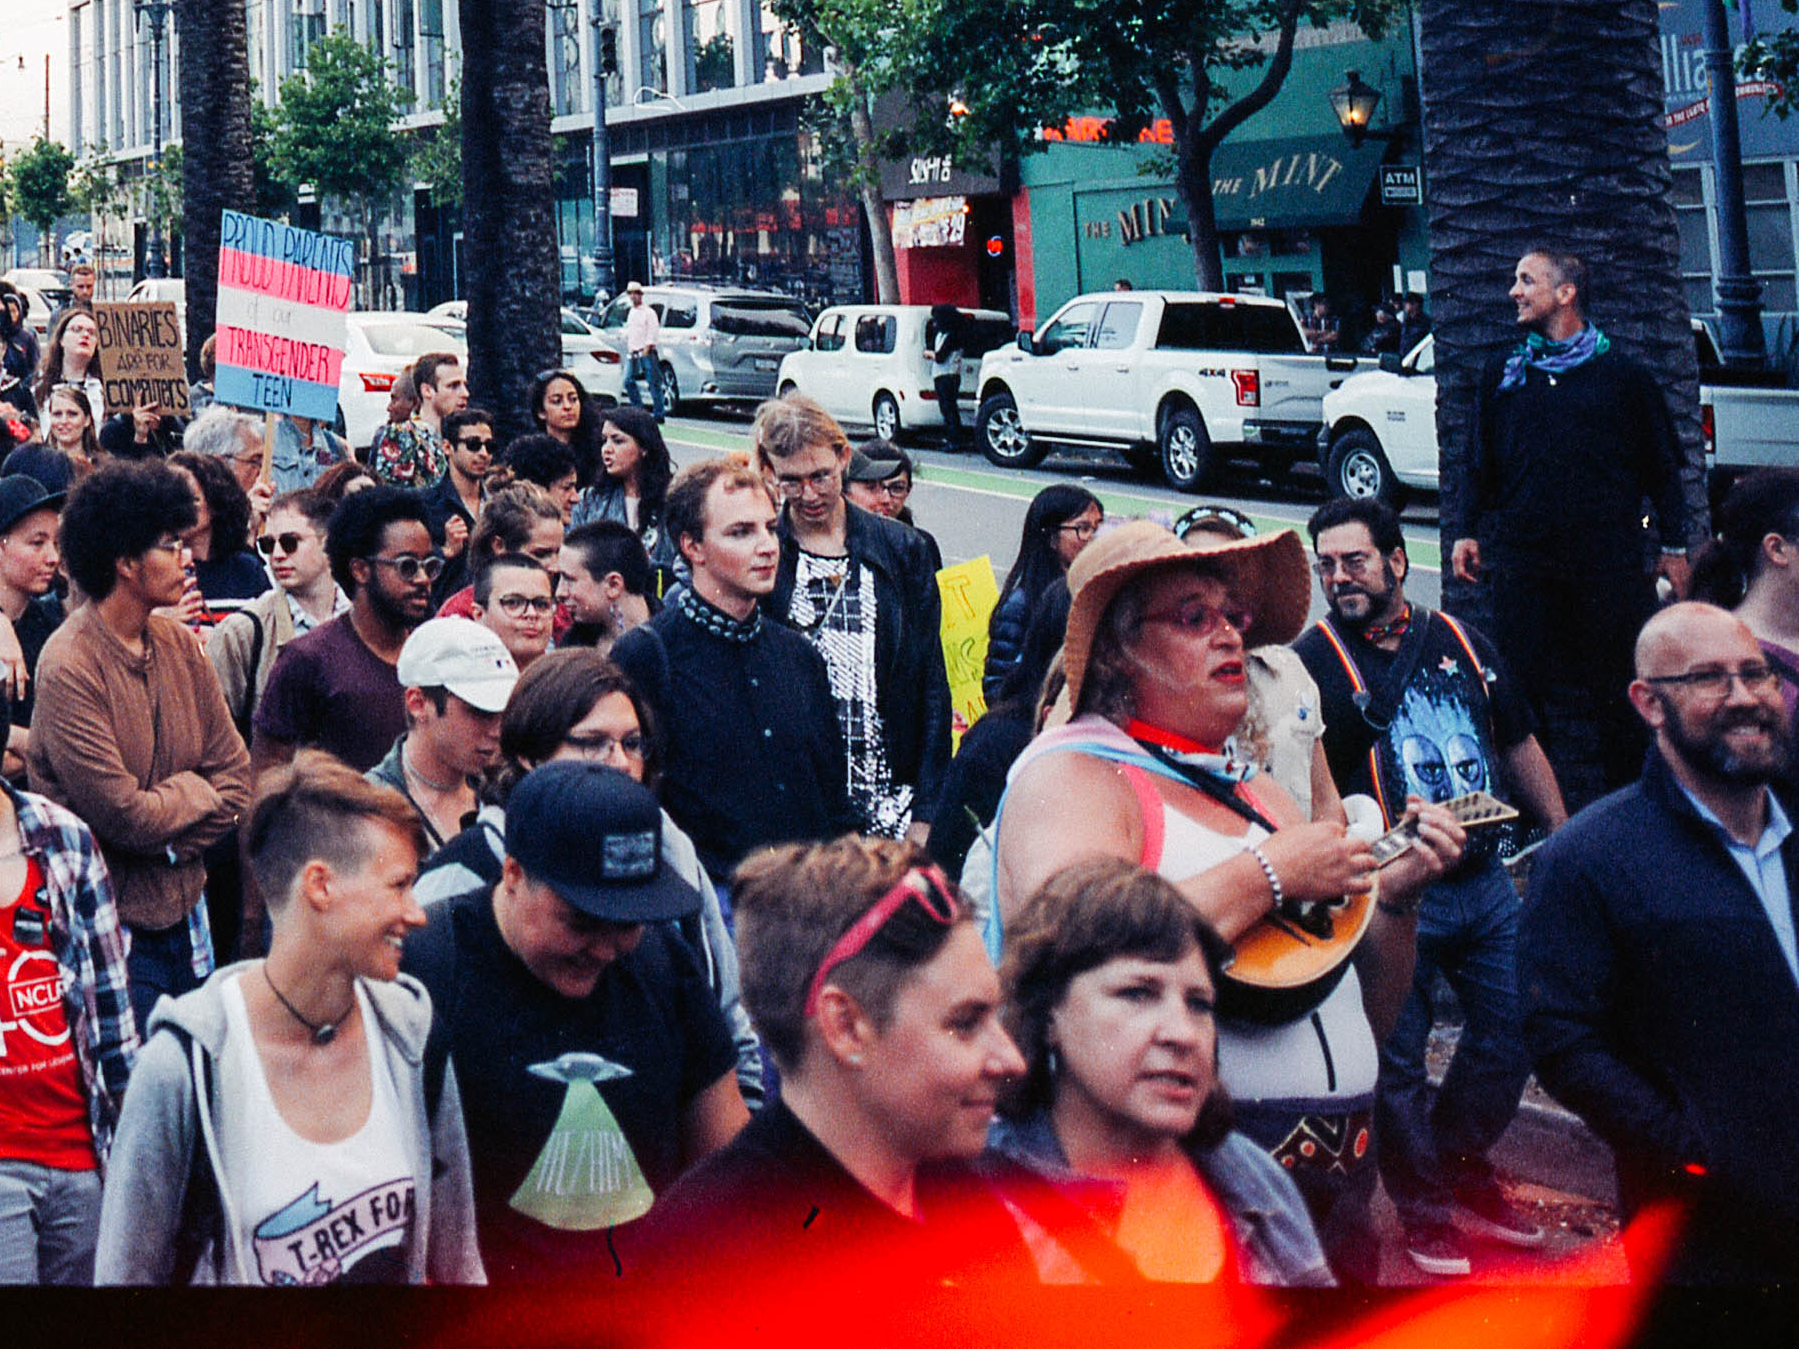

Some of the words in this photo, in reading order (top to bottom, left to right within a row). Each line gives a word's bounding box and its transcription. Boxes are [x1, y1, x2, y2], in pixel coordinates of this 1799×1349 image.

[1212, 179, 1242, 195] THE
[1249, 153, 1343, 200] MINT
[1385, 173, 1415, 184] ATM
[1084, 220, 1110, 239] THE
[1117, 197, 1191, 246] MIN
[221, 213, 275, 291] PROUD
[282, 227, 353, 309] PARENTS
[97, 308, 177, 348] BINARIES
[273, 307, 292, 325] our
[117, 353, 143, 371] ARE
[146, 353, 175, 371] FOR
[228, 327, 330, 383] TRANSGENDER
[252, 373, 292, 408] TEEN
[287, 1209, 365, 1272] T-REX
